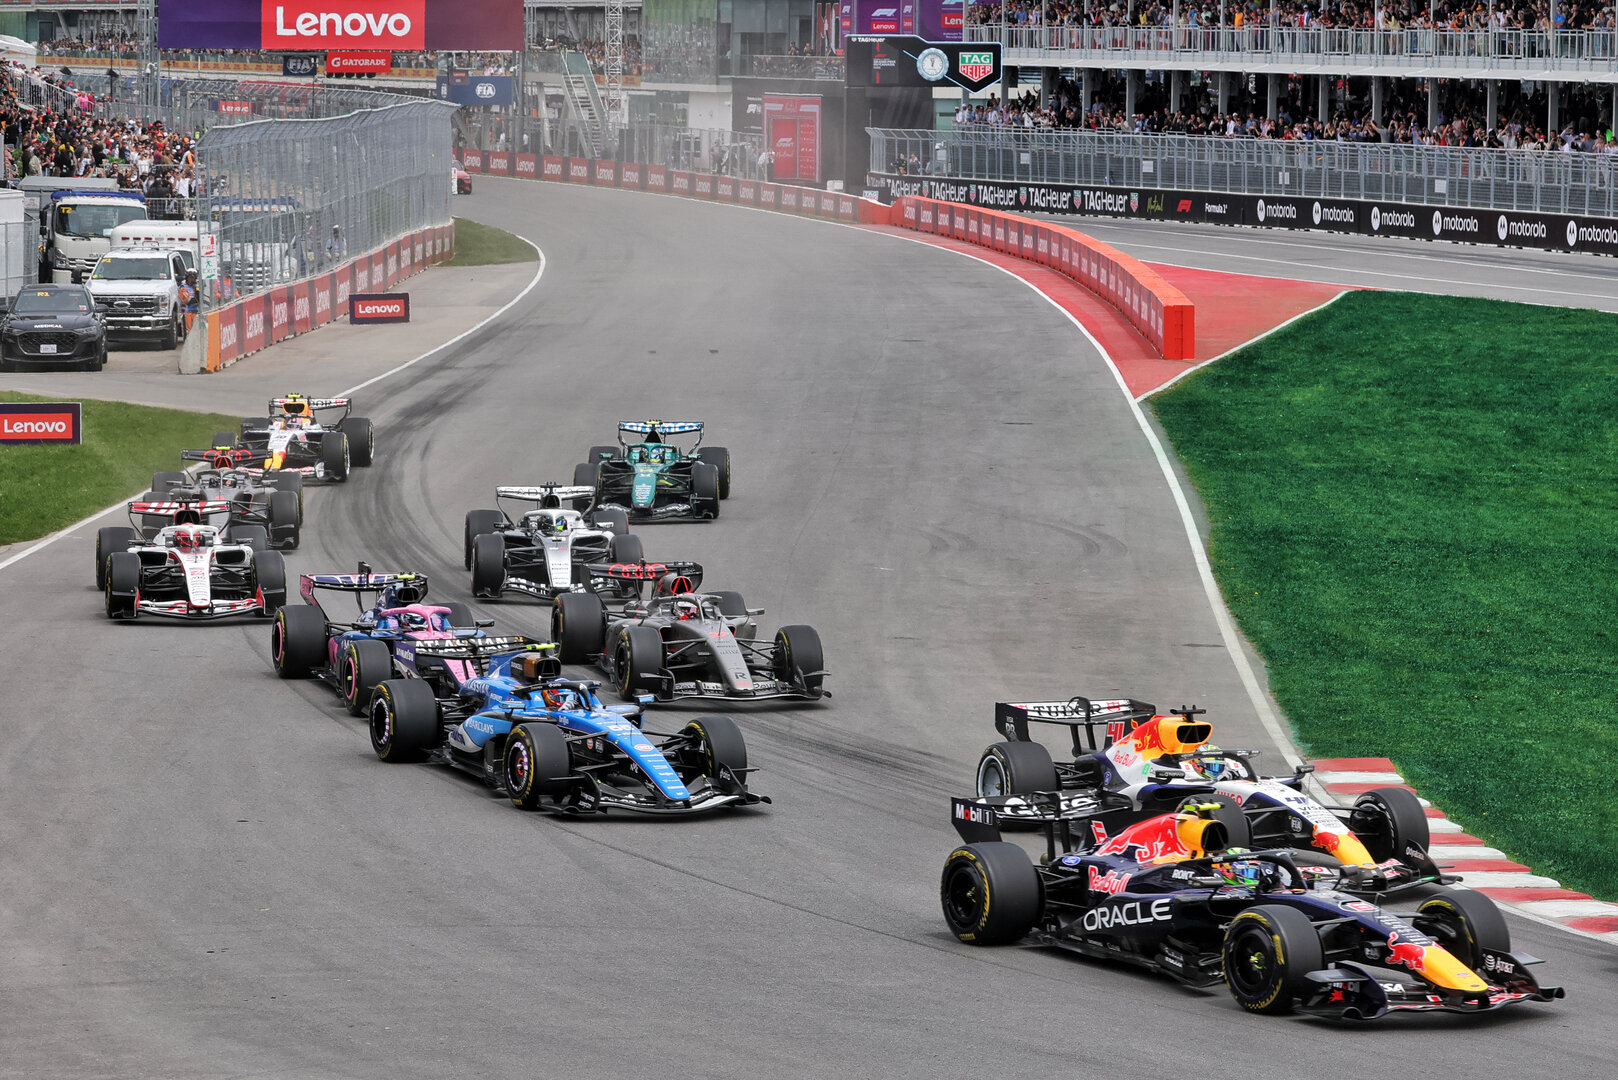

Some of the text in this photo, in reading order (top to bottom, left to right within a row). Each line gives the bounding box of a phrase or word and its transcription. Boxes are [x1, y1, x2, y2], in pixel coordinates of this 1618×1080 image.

[275, 6, 412, 37] Lenovo
[944, 16, 964, 25] Len
[342, 58, 386, 67] GATORADE
[962, 53, 991, 64] TAG
[960, 64, 992, 80] HEUER
[475, 84, 496, 98] FIA
[464, 153, 482, 168] Lenovo
[489, 156, 508, 170] Lenovo
[516, 157, 535, 173] Lenovo
[544, 161, 562, 176] Lenovo
[569, 162, 588, 178] Lenovo
[596, 165, 614, 182] Lenovo
[622, 168, 639, 184] Lenovo
[648, 170, 665, 186] Lenovo
[673, 174, 689, 190] Lenovo
[695, 178, 711, 193] Lenovo
[930, 181, 968, 203] TAGHeuer
[977, 184, 1018, 206] TAGHeuer
[1028, 187, 1072, 210] TAGHeuer
[1083, 190, 1128, 213] TAGHeuer
[1205, 203, 1223, 214] Formula
[1266, 203, 1297, 219] motorola
[1322, 206, 1355, 223] motorola
[1381, 210, 1415, 228] motorola
[1443, 215, 1479, 232] motorola
[1509, 219, 1547, 238] motorola
[1578, 225, 1618, 245] motorola
[294, 295, 310, 322] Lenovo
[315, 287, 331, 313] Lenovo
[358, 302, 401, 315] Lenovo
[272, 300, 287, 329] Lenovo
[220, 321, 237, 350] Lenovo
[3, 419, 67, 434] Lenovo
[415, 636, 509, 653] ATLASIAN
[469, 718, 494, 735] BARCLAYS
[1106, 721, 1126, 744] 41
[1122, 753, 1138, 768] Bull
[955, 803, 983, 823] Mobil
[1101, 869, 1133, 895] Bull
[1083, 898, 1173, 931] ORACLE
[1495, 957, 1515, 974] AT&T
